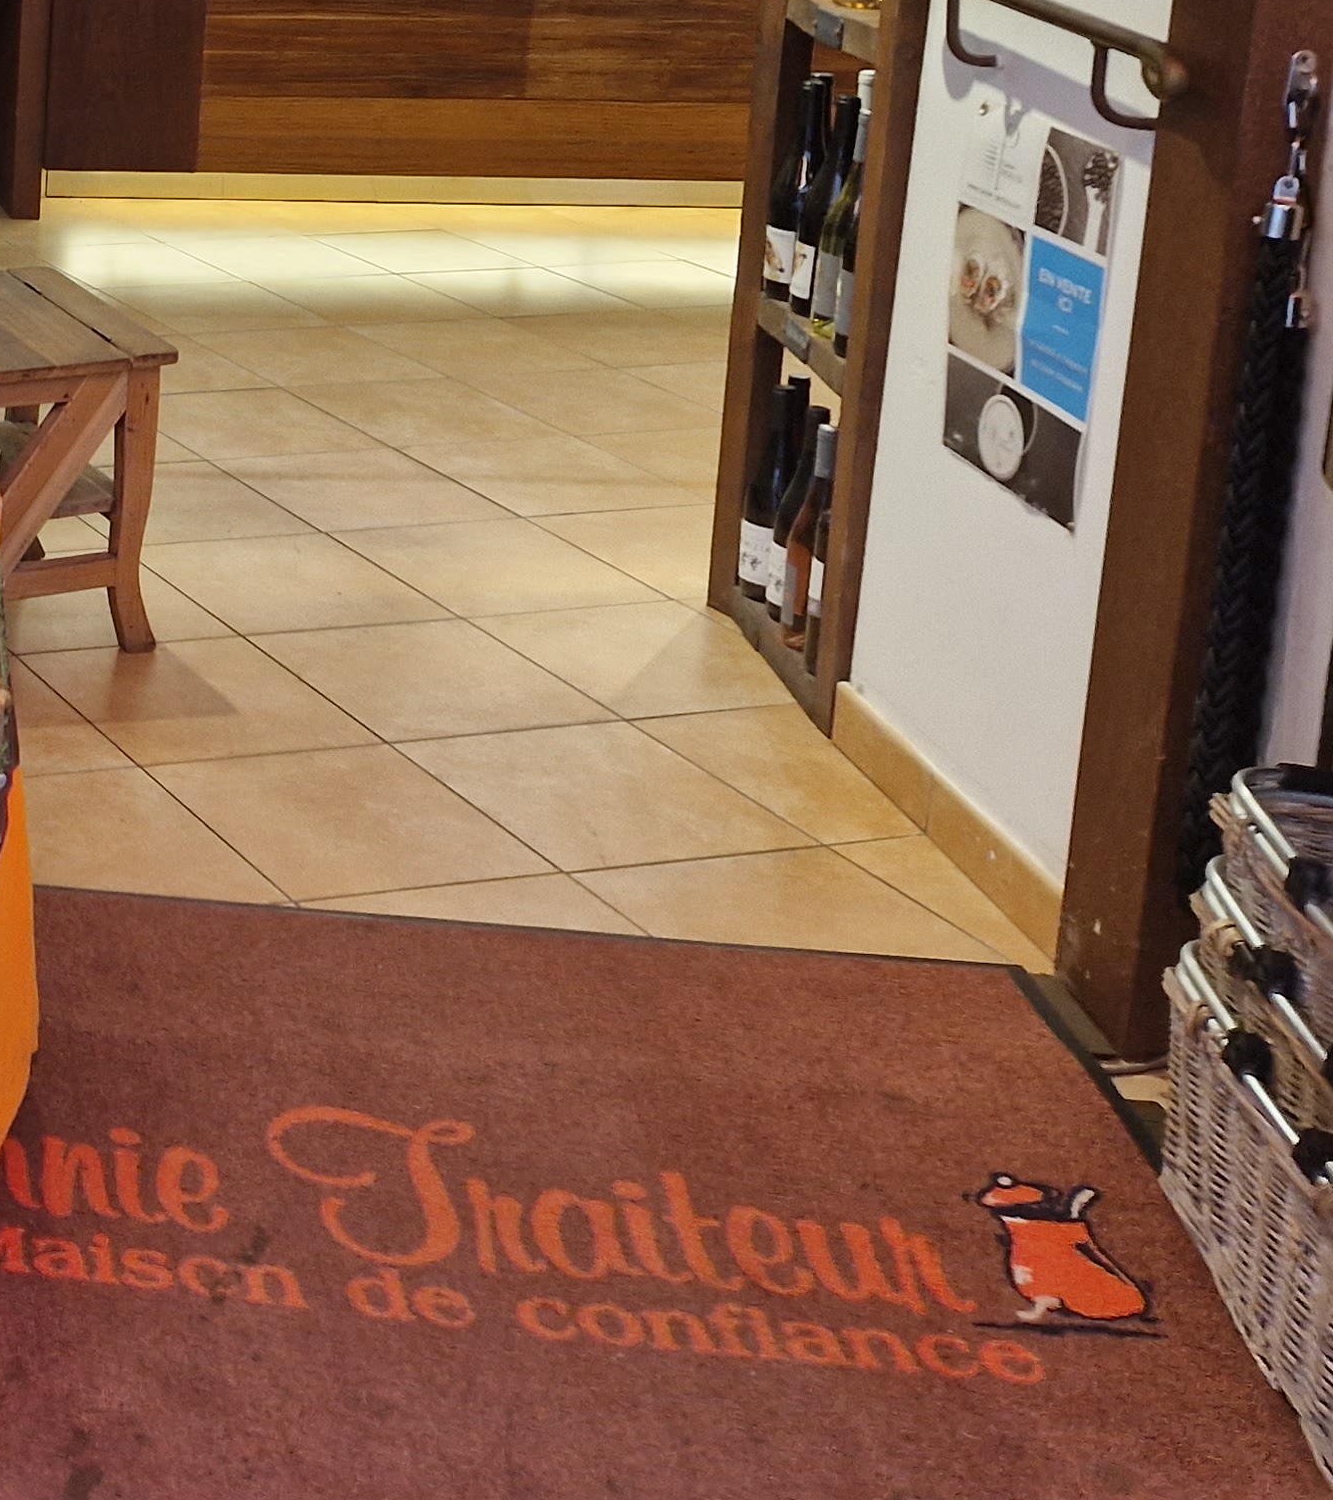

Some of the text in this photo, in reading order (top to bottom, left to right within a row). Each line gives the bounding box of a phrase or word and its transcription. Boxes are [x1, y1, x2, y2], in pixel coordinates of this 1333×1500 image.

[269, 1106, 975, 1316] Traiteur
[347, 1266, 475, 1329] de
[520, 1300, 1044, 1386] confiance
